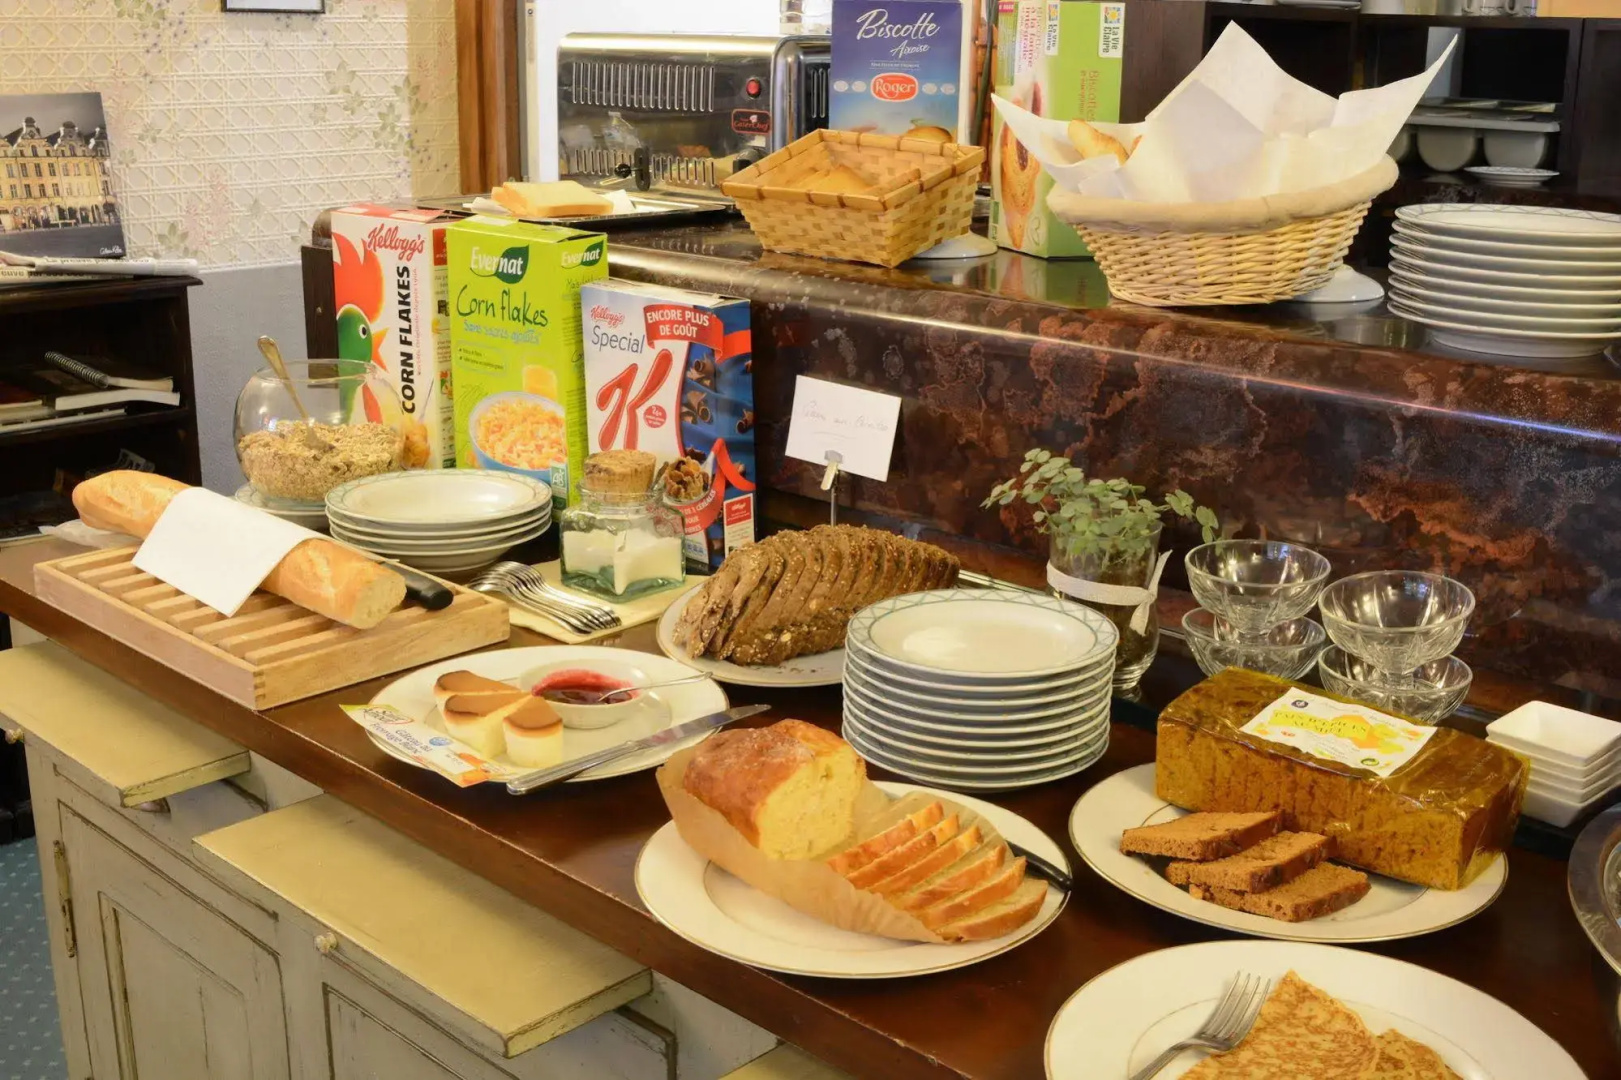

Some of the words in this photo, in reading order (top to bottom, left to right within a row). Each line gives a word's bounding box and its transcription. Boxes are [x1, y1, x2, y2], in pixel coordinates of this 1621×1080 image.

[856, 8, 940, 40] Biscotte
[1112, 26, 1120, 36] La
[1102, 26, 1112, 53] Claire
[1111, 37, 1120, 50] Vie
[875, 77, 915, 99] Roger
[367, 223, 425, 262] Kellogg's
[561, 247, 600, 266] Evernat
[470, 246, 523, 275] Evernat
[396, 265, 412, 346] FLAKES
[456, 284, 495, 318] Corn
[500, 289, 548, 327] flakes
[590, 304, 625, 328] Kellogg's
[646, 309, 683, 324] ENCORE
[685, 310, 709, 326] PLUS
[591, 325, 645, 354] Special
[659, 324, 672, 335] DE
[673, 323, 698, 338] GOÛT
[400, 352, 416, 414] CORN
[596, 348, 673, 451] K
